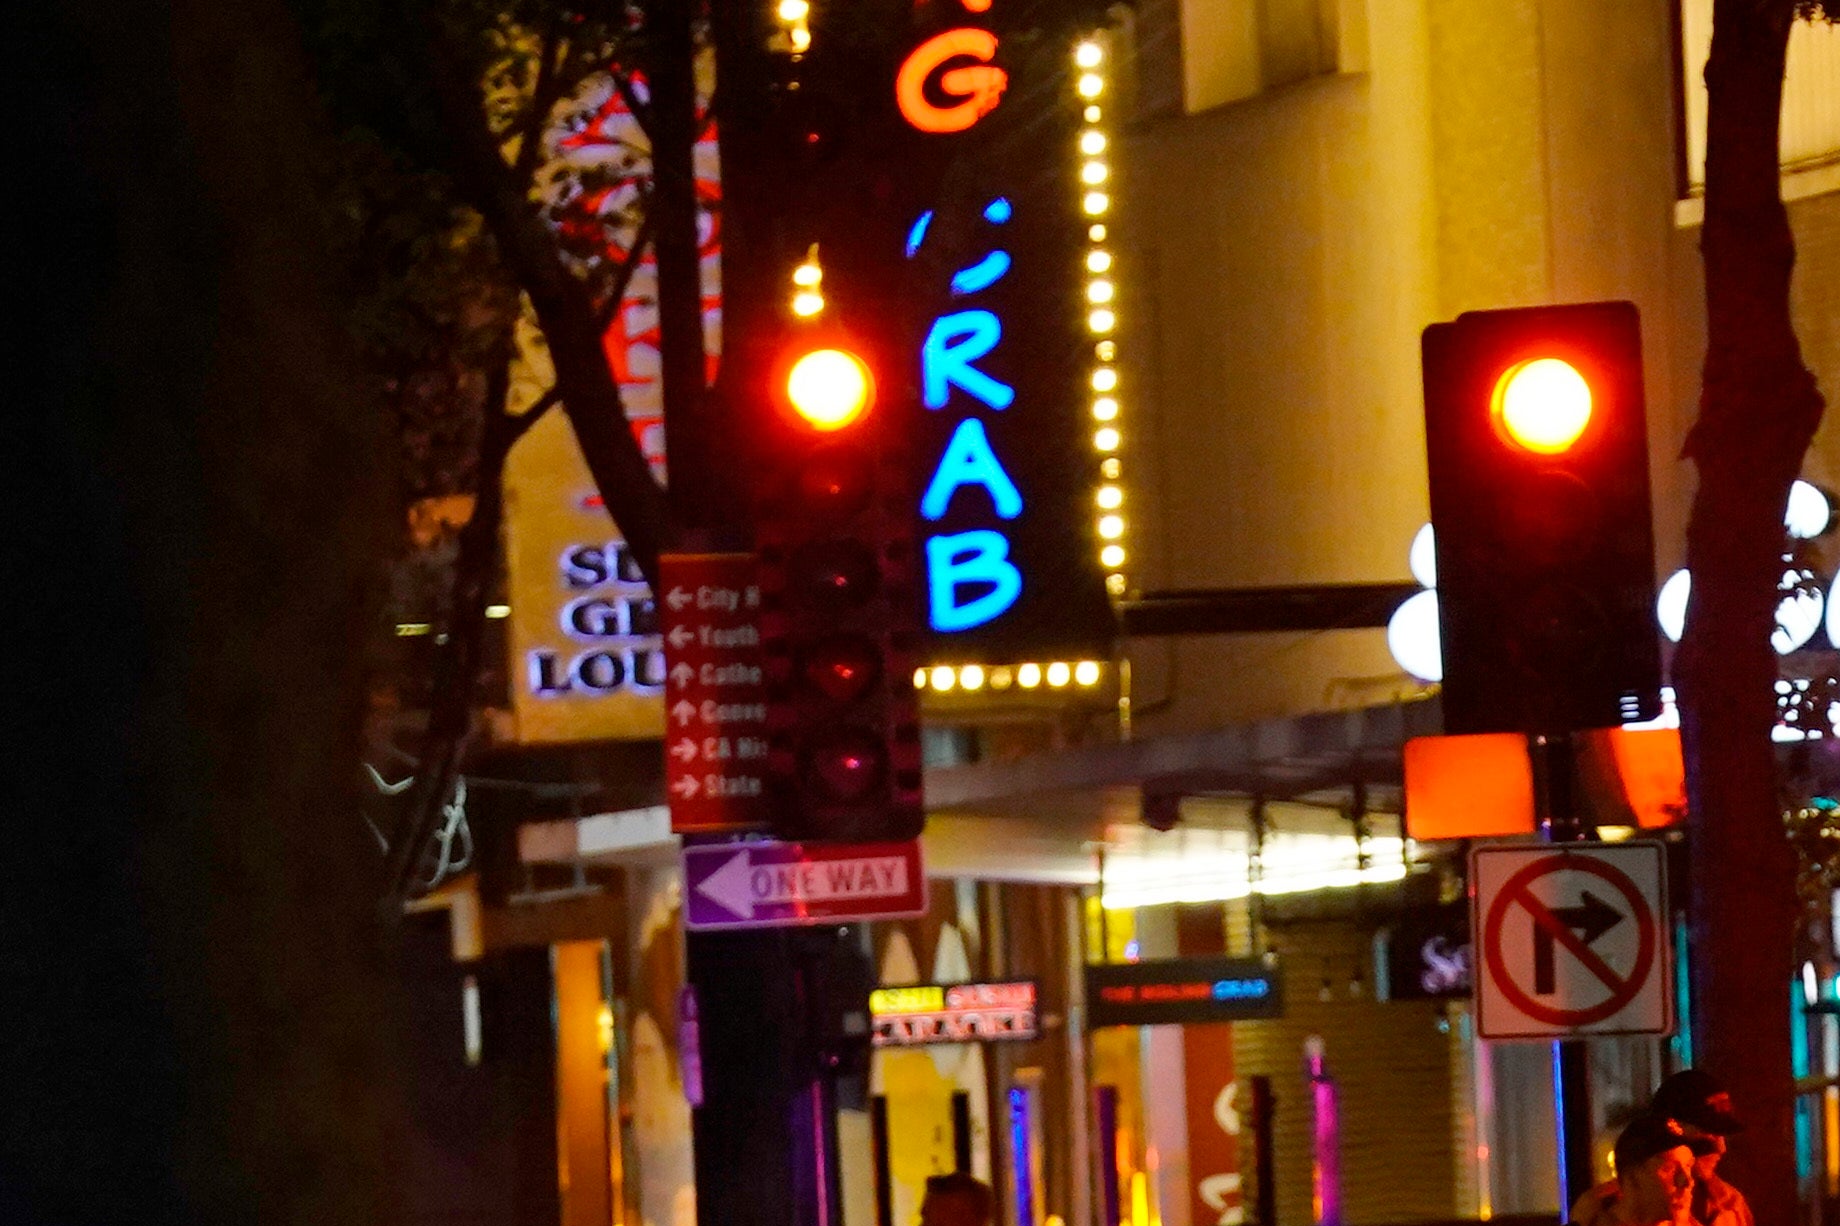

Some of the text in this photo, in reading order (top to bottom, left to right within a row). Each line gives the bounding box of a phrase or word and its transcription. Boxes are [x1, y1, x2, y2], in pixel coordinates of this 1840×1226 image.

[896, 0, 1008, 133] G
[745, 585, 760, 608] H
[528, 648, 667, 695] LOU
[701, 662, 762, 686] Cathe
[751, 861, 899, 899] ONE WAY
